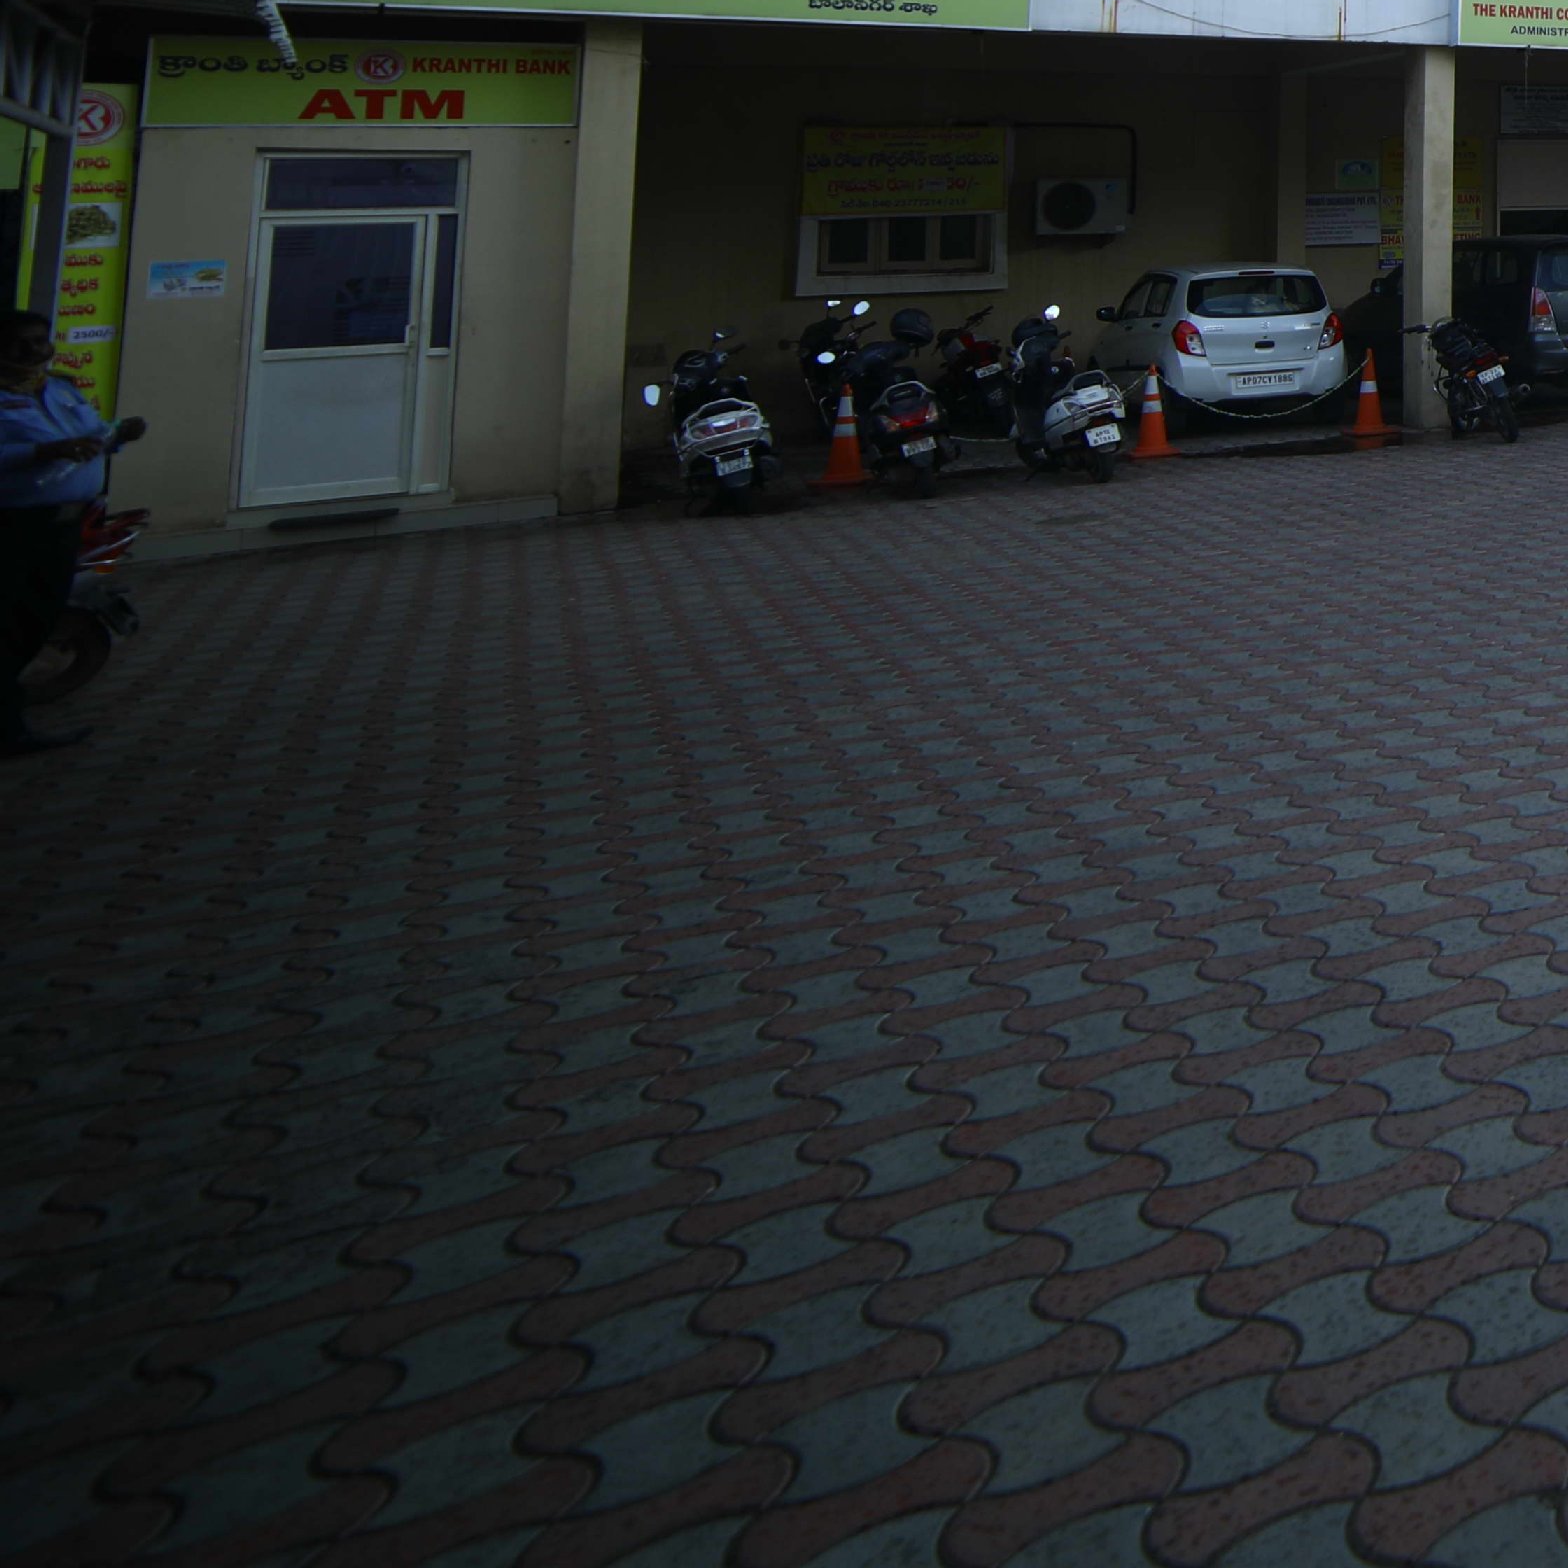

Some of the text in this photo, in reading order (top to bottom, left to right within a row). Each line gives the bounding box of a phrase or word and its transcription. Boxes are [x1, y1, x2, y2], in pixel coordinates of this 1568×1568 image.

[1472, 2, 1496, 18] THE
[1499, 5, 1553, 20] KRANTHI
[158, 53, 248, 79] క్రాంతి
[412, 56, 571, 76] KRANTHI BANK
[298, 88, 466, 120] ATM
